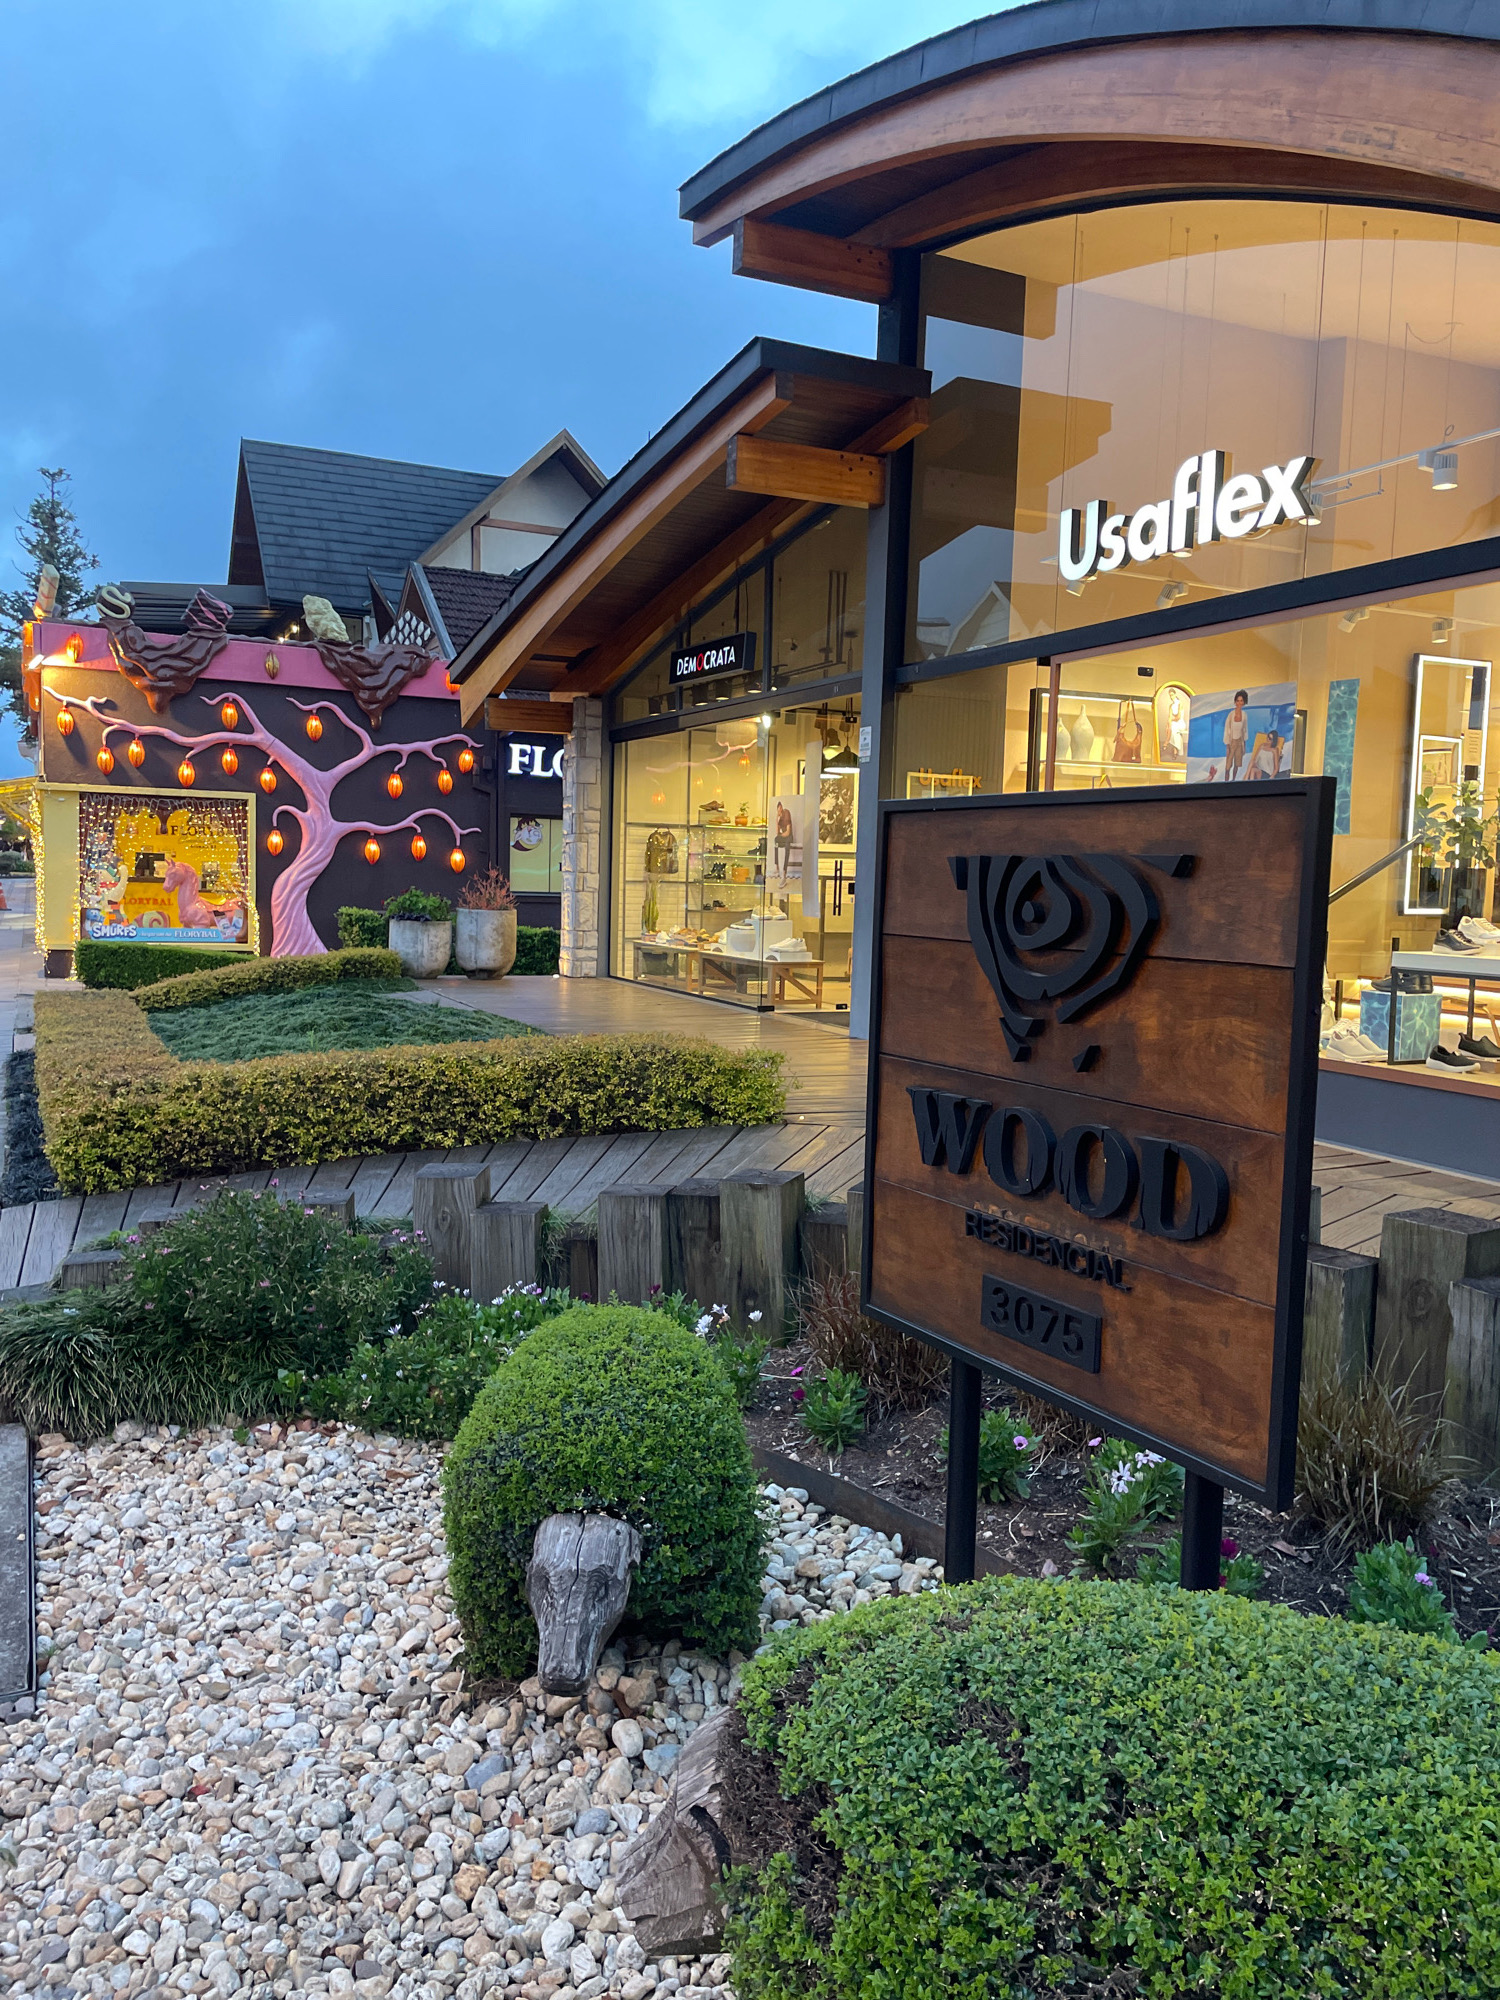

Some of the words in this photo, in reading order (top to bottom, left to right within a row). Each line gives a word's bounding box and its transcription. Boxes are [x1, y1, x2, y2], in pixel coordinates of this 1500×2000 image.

[1059, 449, 1312, 581] Usaflex
[676, 646, 736, 676] DEMOCRATA
[174, 929, 218, 938] FLORYBAL
[905, 1086, 1230, 1241] WOOD
[965, 1208, 1133, 1293] RESIDENCIAL
[989, 1285, 1085, 1359] 3075
